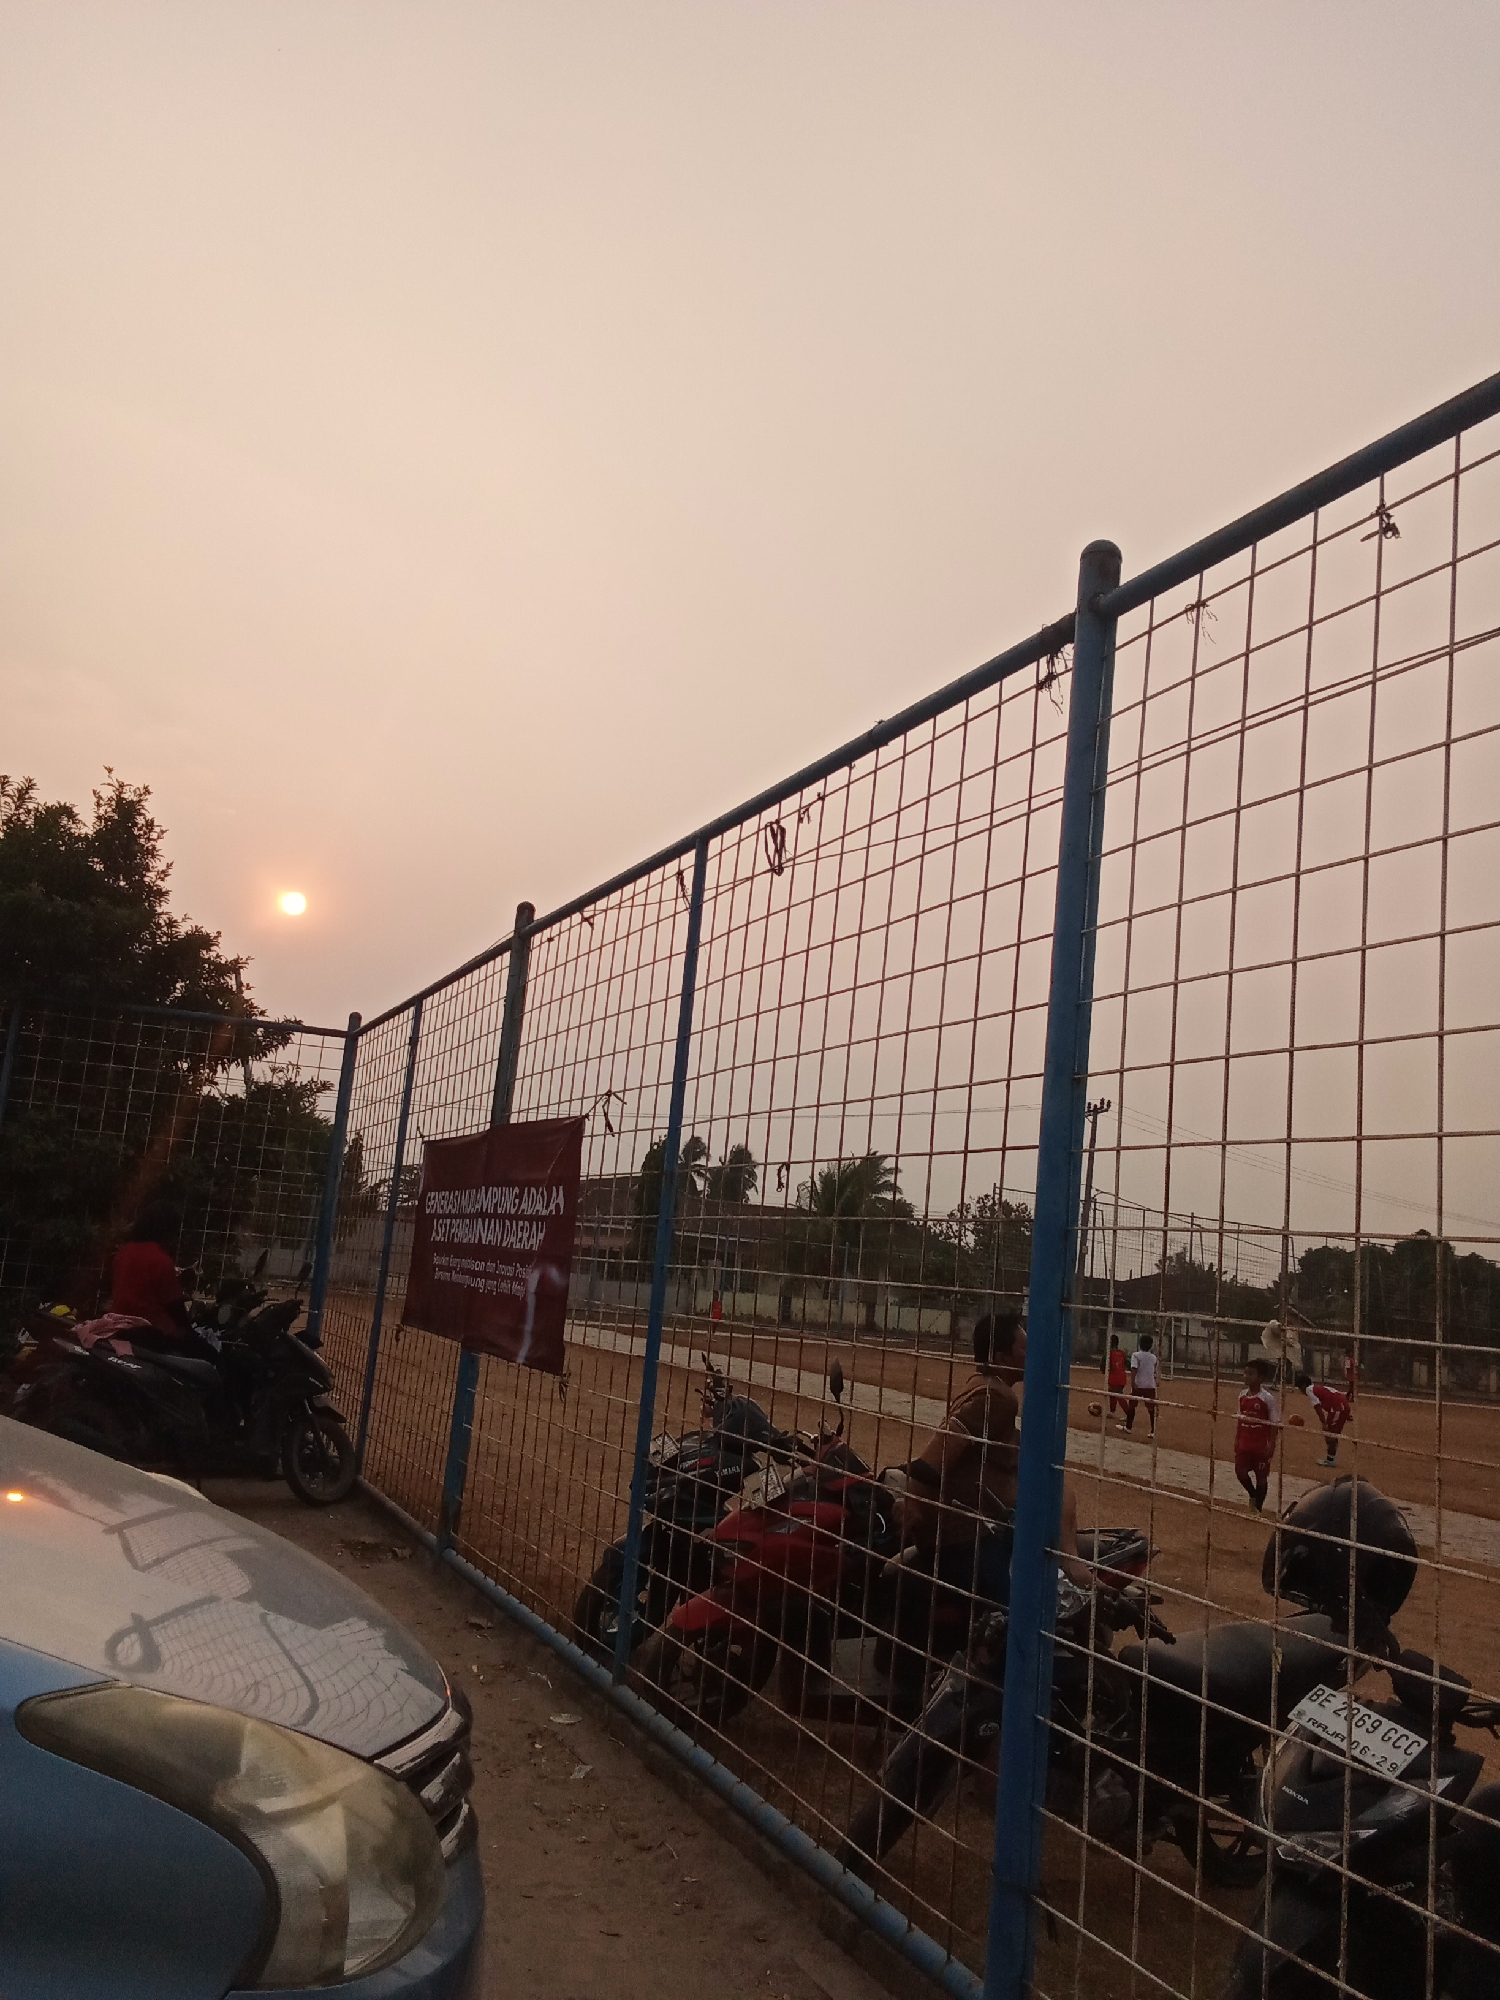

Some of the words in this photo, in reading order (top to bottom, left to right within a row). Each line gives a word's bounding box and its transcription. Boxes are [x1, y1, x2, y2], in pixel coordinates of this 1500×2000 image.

[502, 1220, 547, 1251] DAERAH
[1308, 1687, 1337, 1708] BE
[1381, 1727, 1422, 1757] GCC
